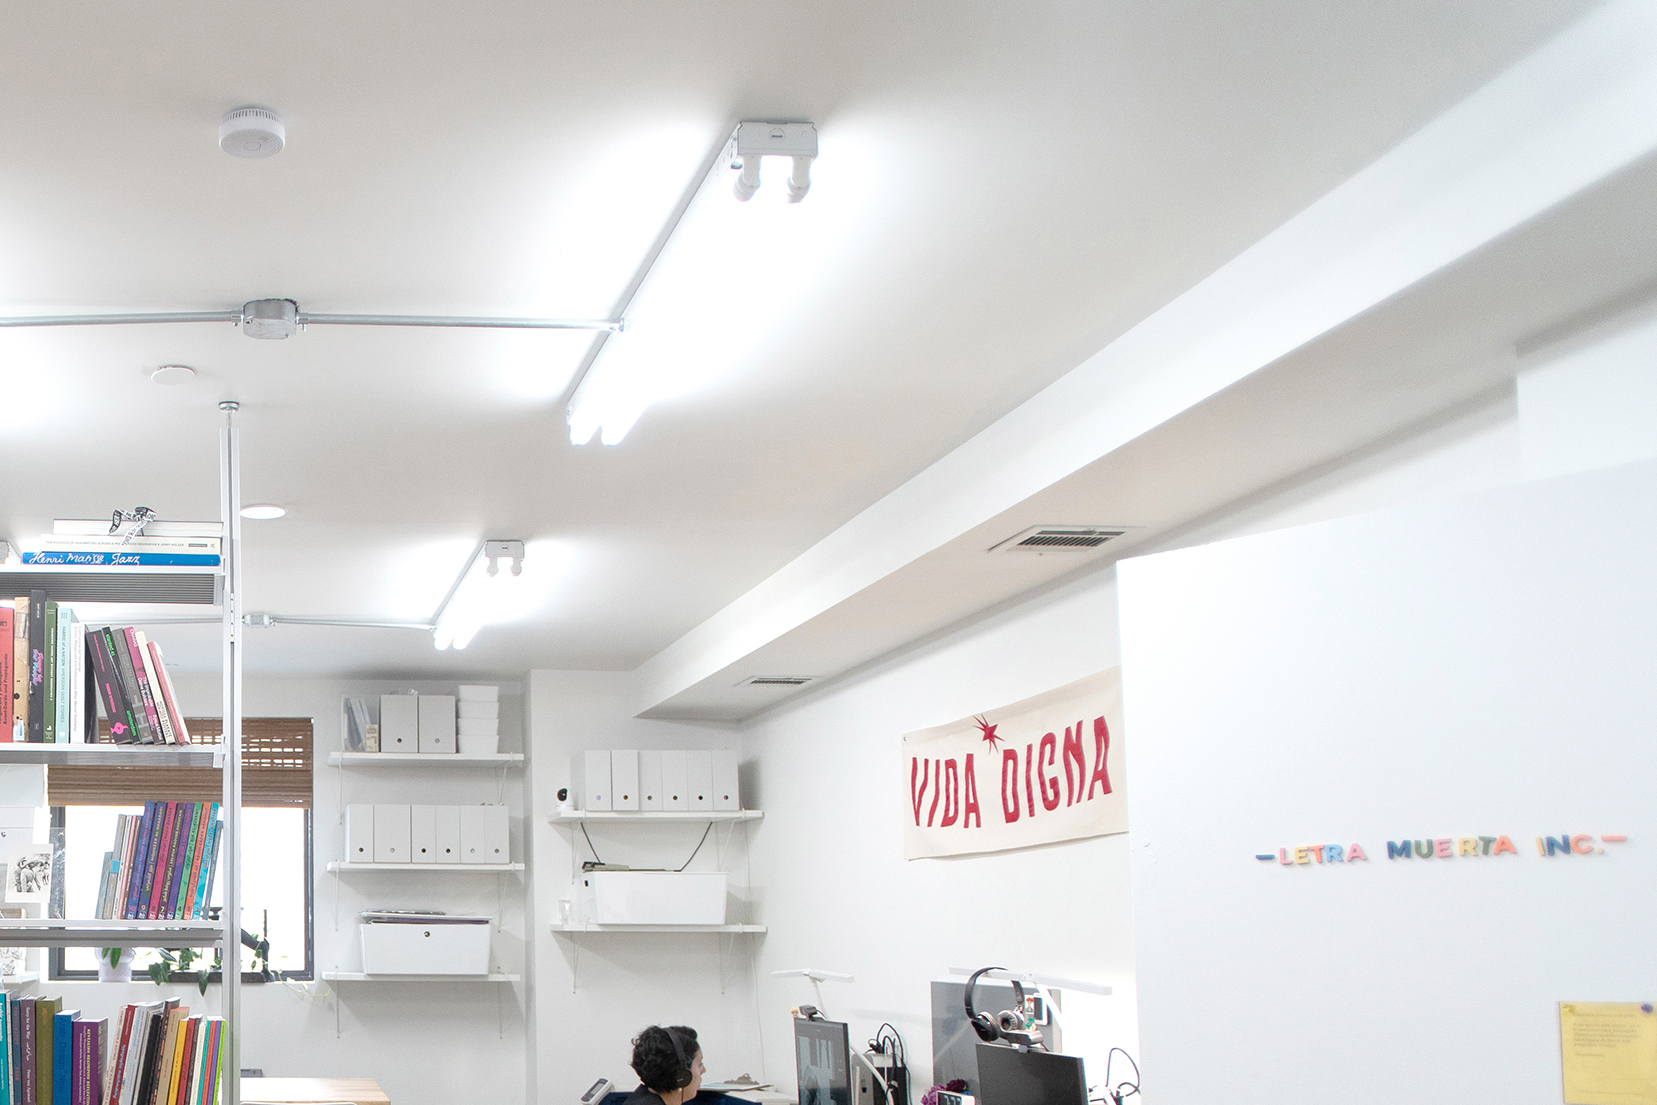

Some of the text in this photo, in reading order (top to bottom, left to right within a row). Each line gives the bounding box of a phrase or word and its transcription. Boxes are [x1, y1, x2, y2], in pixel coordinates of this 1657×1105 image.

[29, 552, 64, 565] Henri
[110, 552, 140, 566] Jazz
[911, 715, 1112, 829] VIDA DIGNA
[1386, 835, 1517, 860] MUERTA
